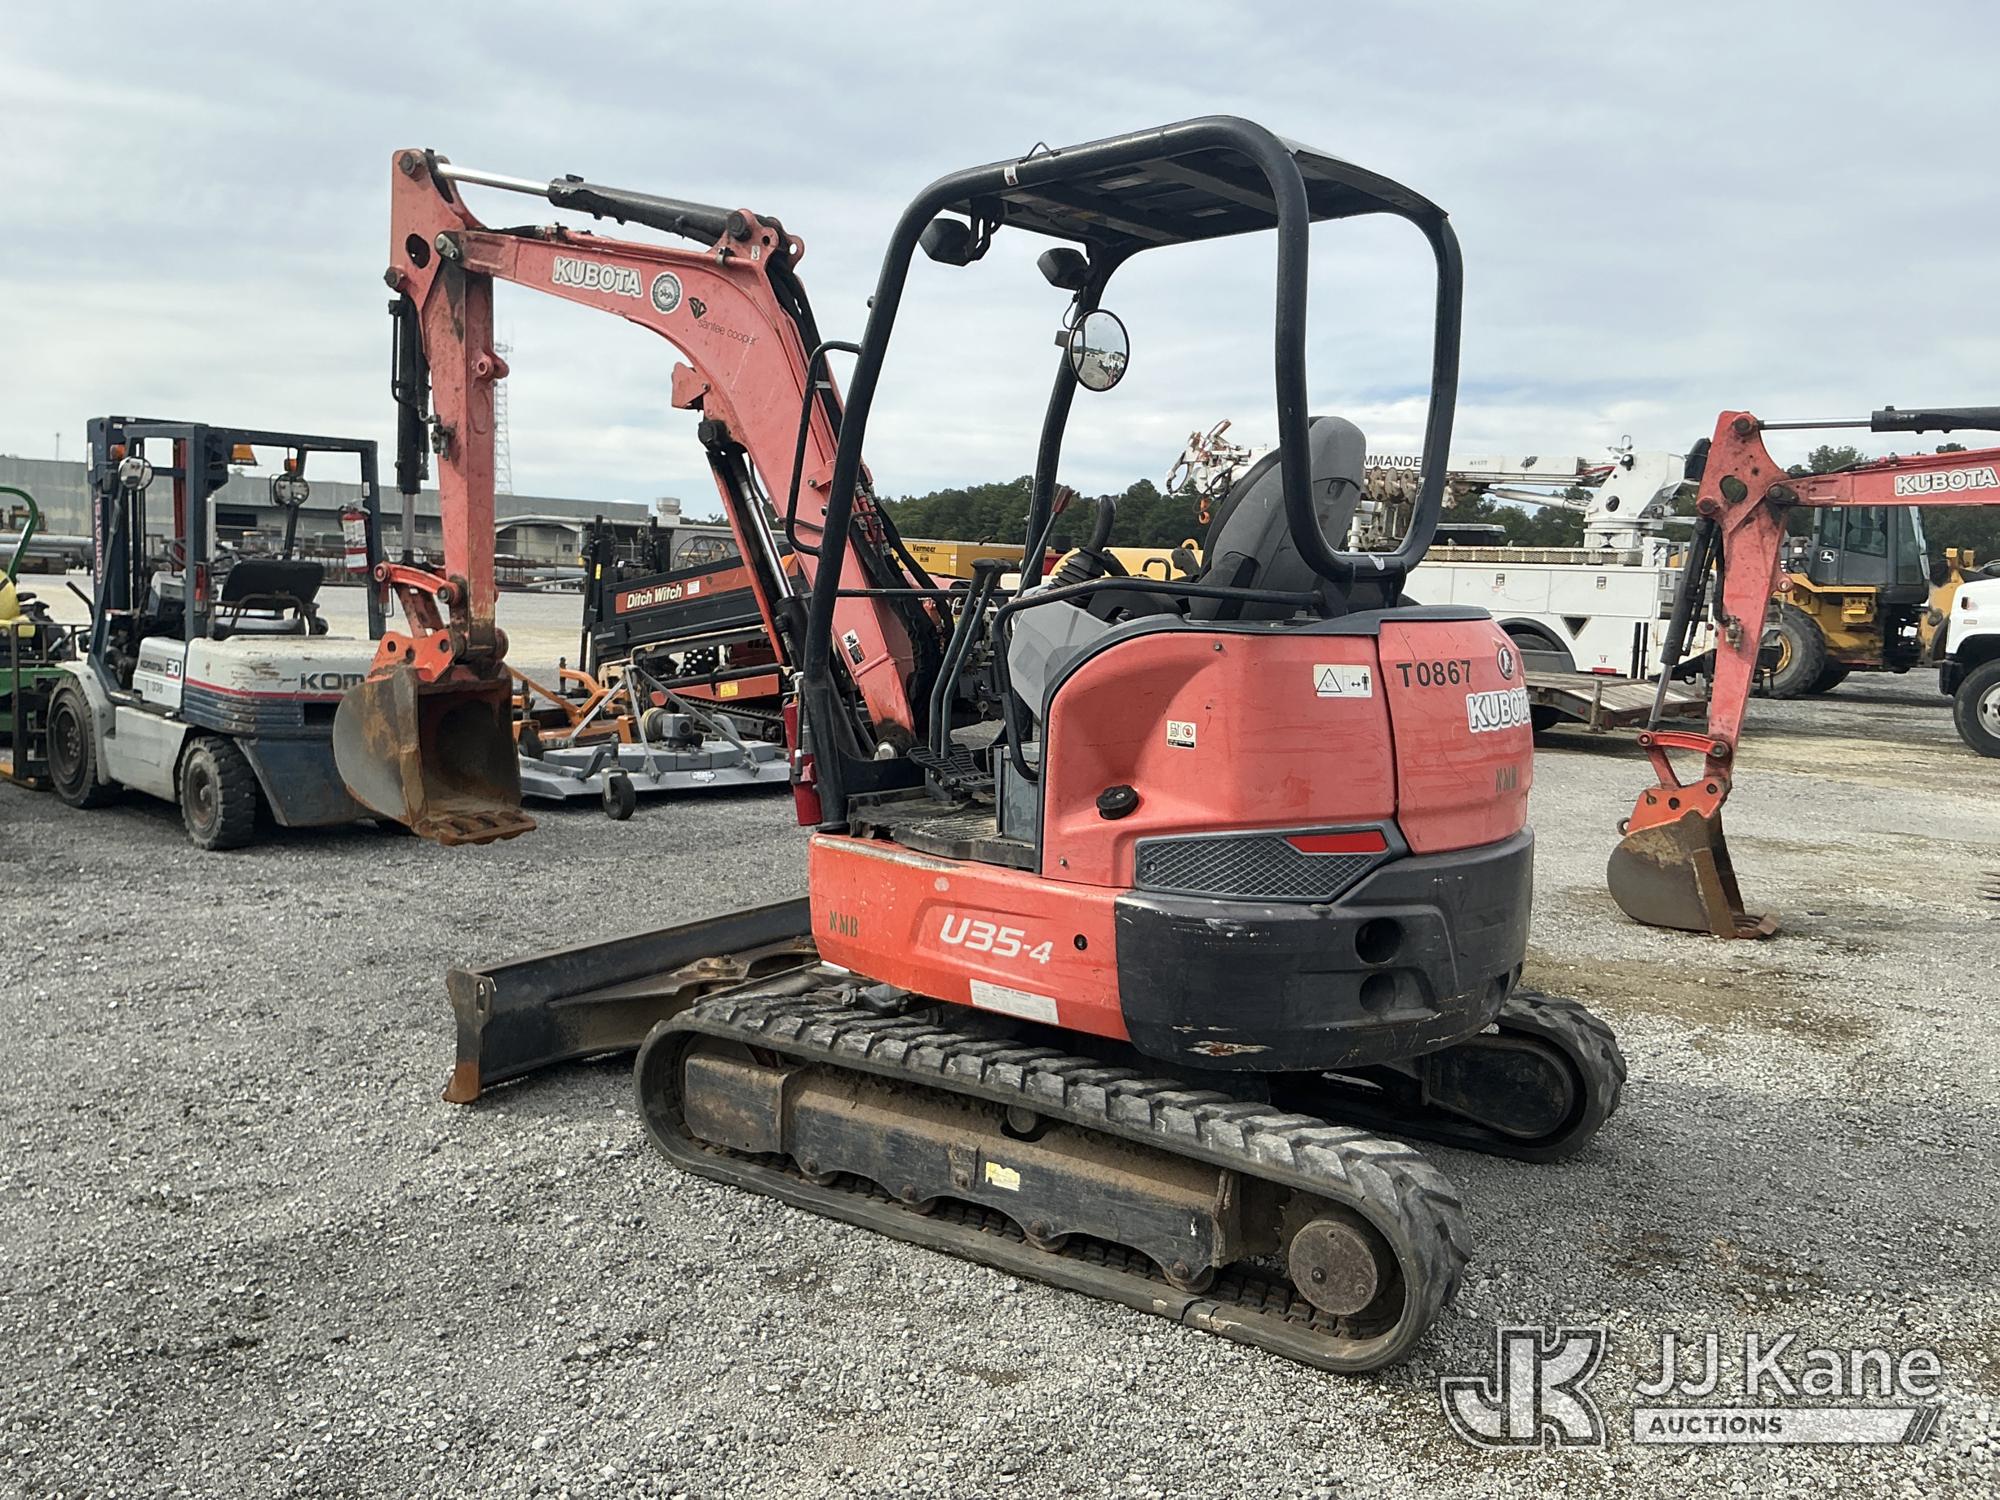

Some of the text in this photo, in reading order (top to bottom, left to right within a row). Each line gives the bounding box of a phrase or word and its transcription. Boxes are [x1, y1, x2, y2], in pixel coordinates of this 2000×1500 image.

[553, 257, 642, 296] KUBOTA
[697, 318, 726, 336] santee
[1895, 467, 1999, 495] KUBOTA
[912, 543, 936, 553] Vermeer
[626, 591, 653, 609] Ditch
[654, 583, 683, 603] Witch
[1396, 659, 1472, 688] T0867
[940, 913, 1053, 964] U35-4
